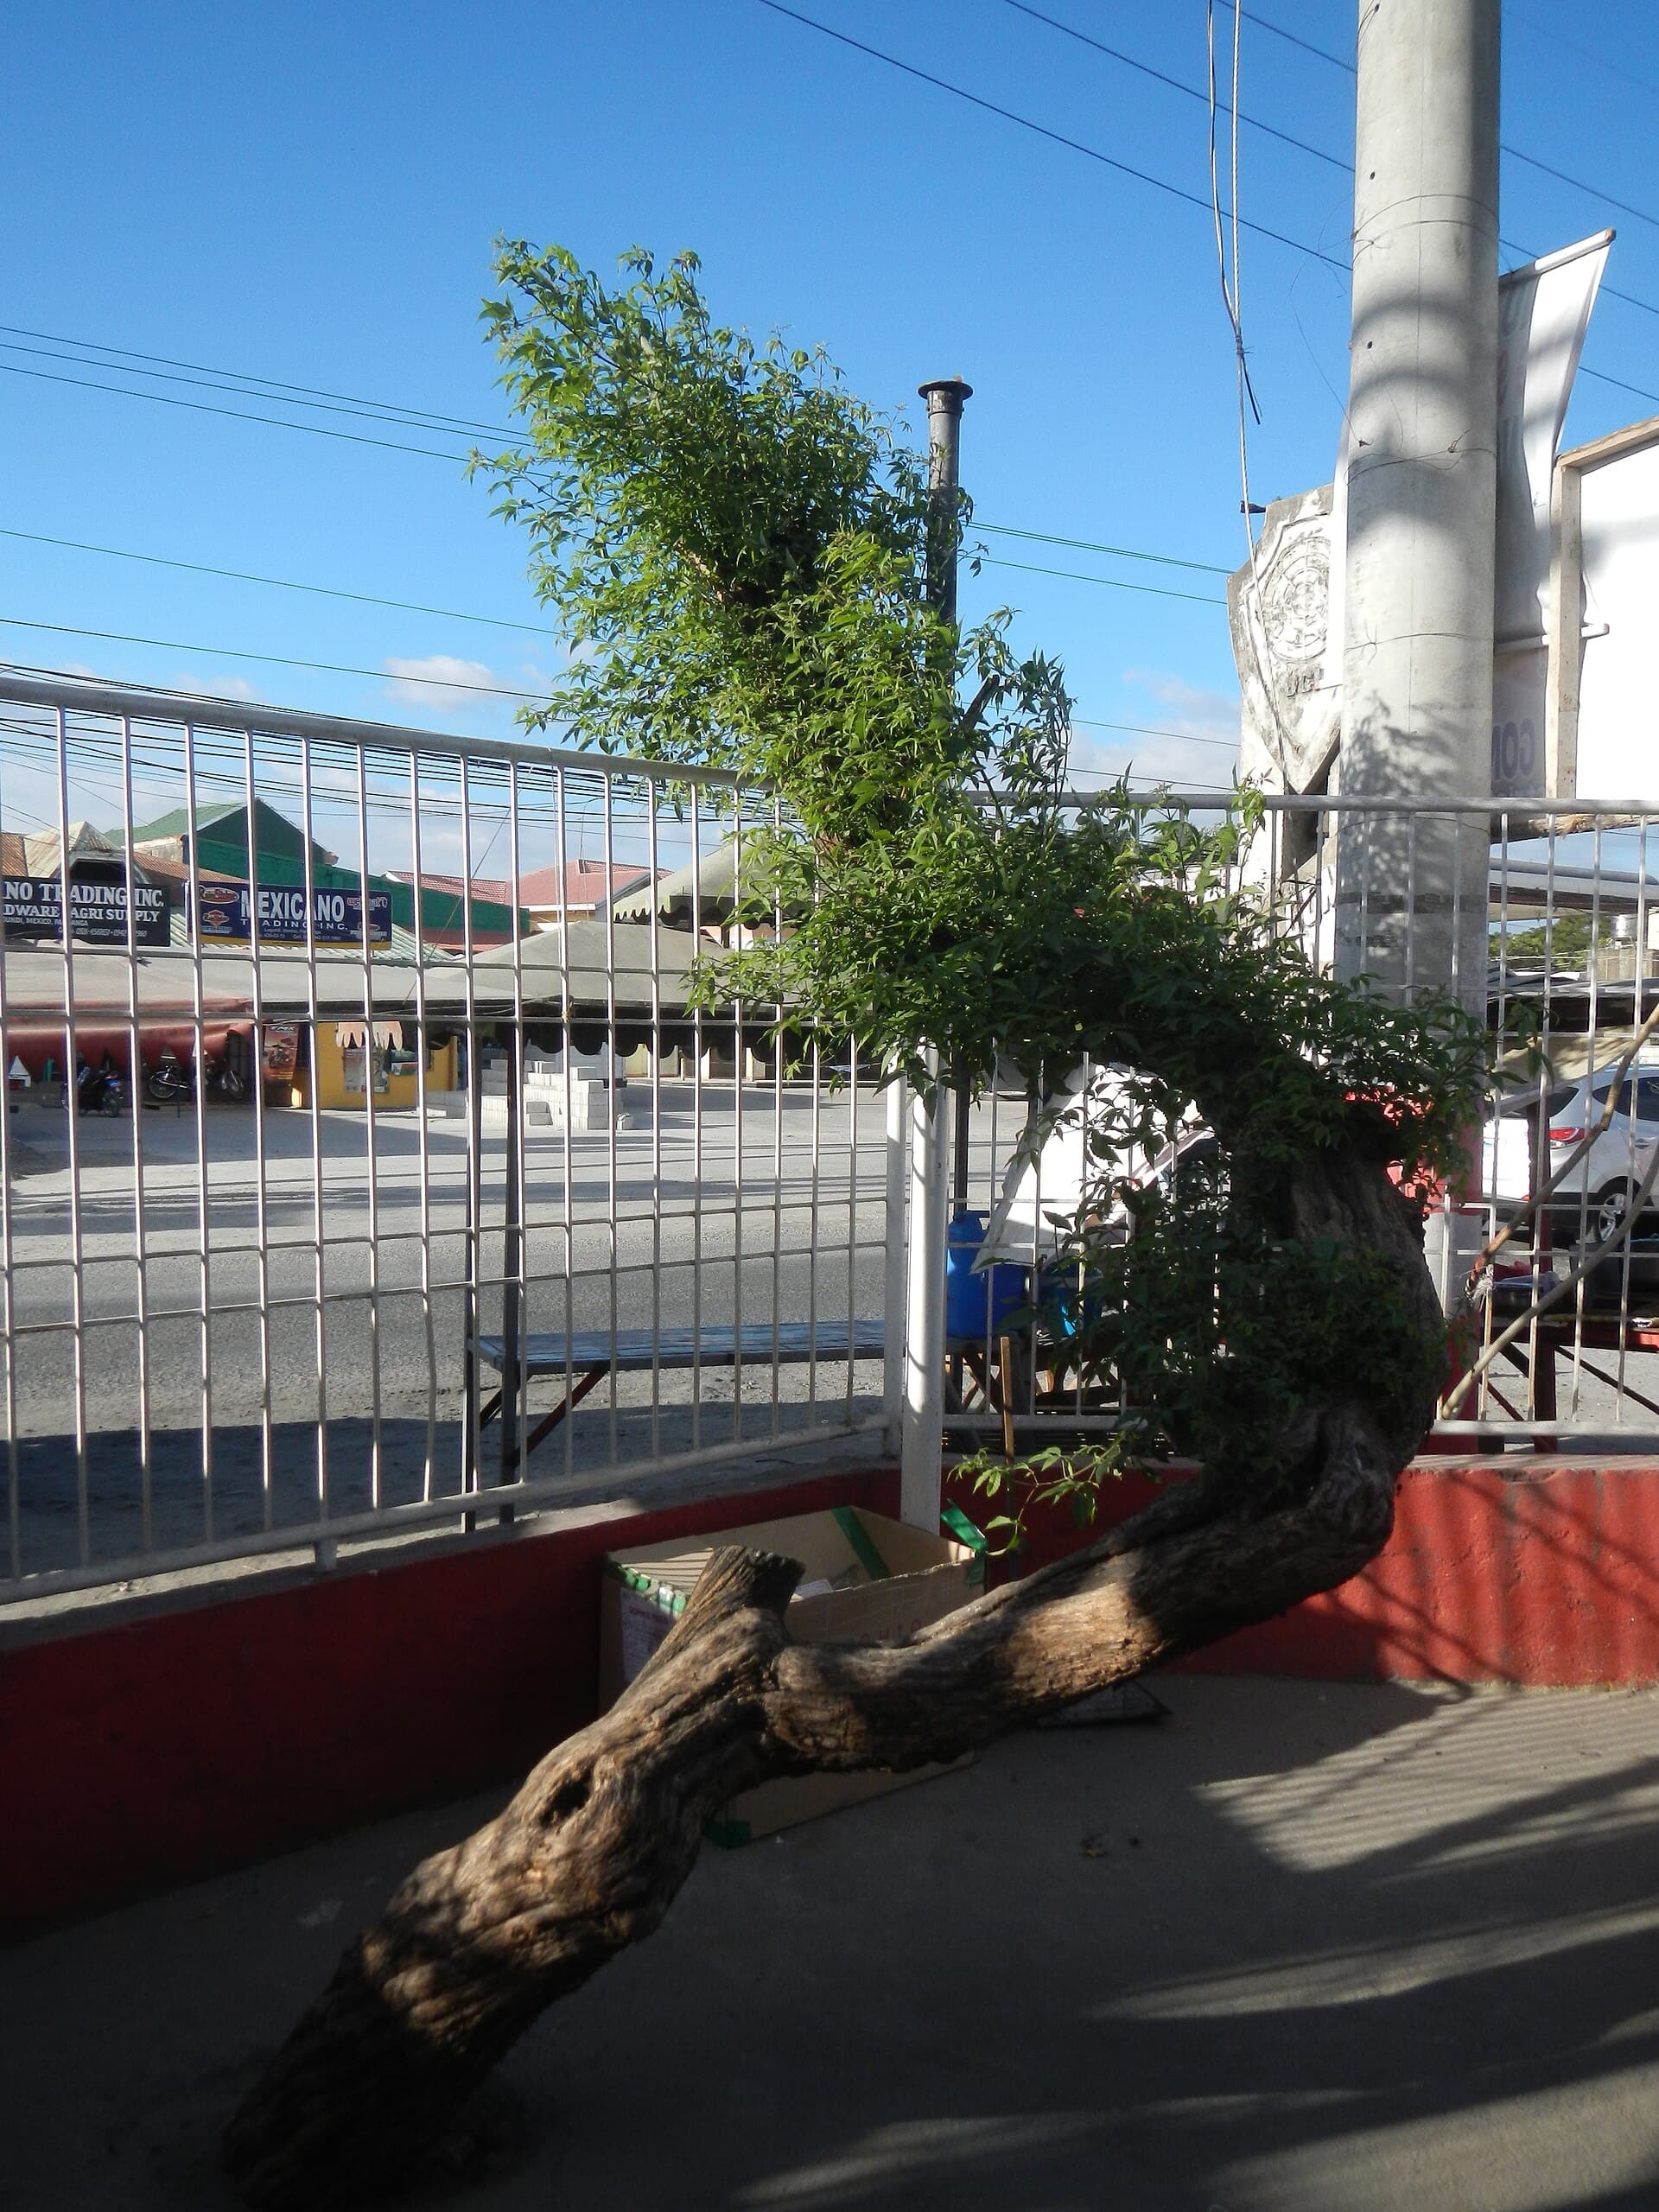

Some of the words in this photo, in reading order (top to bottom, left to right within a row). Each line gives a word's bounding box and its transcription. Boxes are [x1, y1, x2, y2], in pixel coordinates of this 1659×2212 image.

[135, 888, 164, 907] INC.
[71, 907, 104, 919] AGRI
[106, 909, 160, 923] SUPLY
[240, 918, 313, 931] TADING
